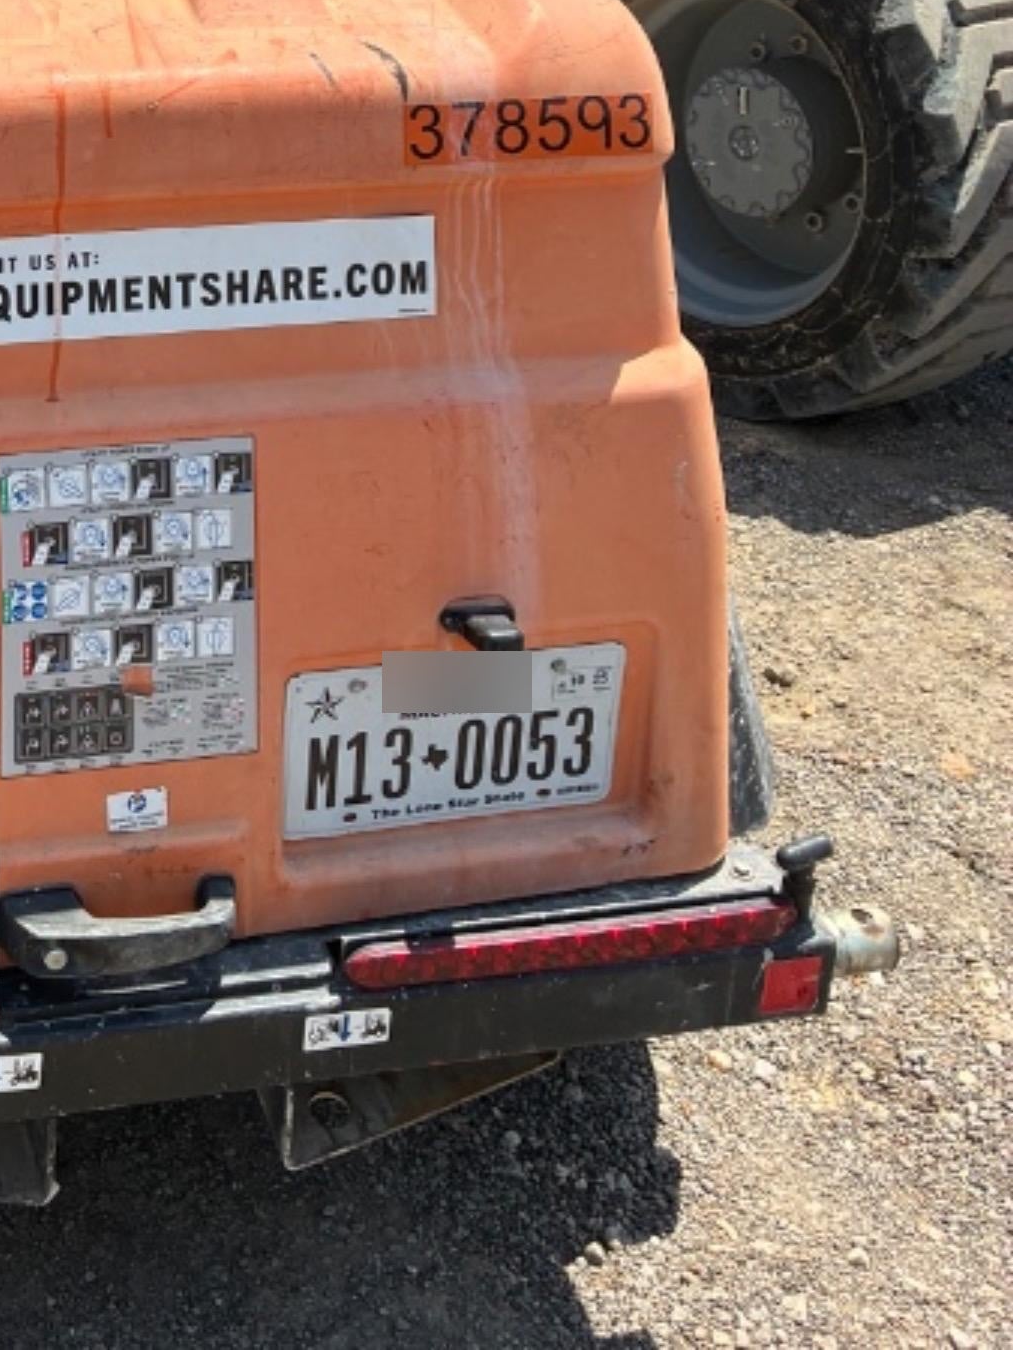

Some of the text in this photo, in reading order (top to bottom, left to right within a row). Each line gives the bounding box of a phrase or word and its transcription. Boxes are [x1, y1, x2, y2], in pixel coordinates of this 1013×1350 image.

[408, 92, 652, 161] 378593
[28, 253, 57, 271] US
[66, 250, 100, 269] AT:
